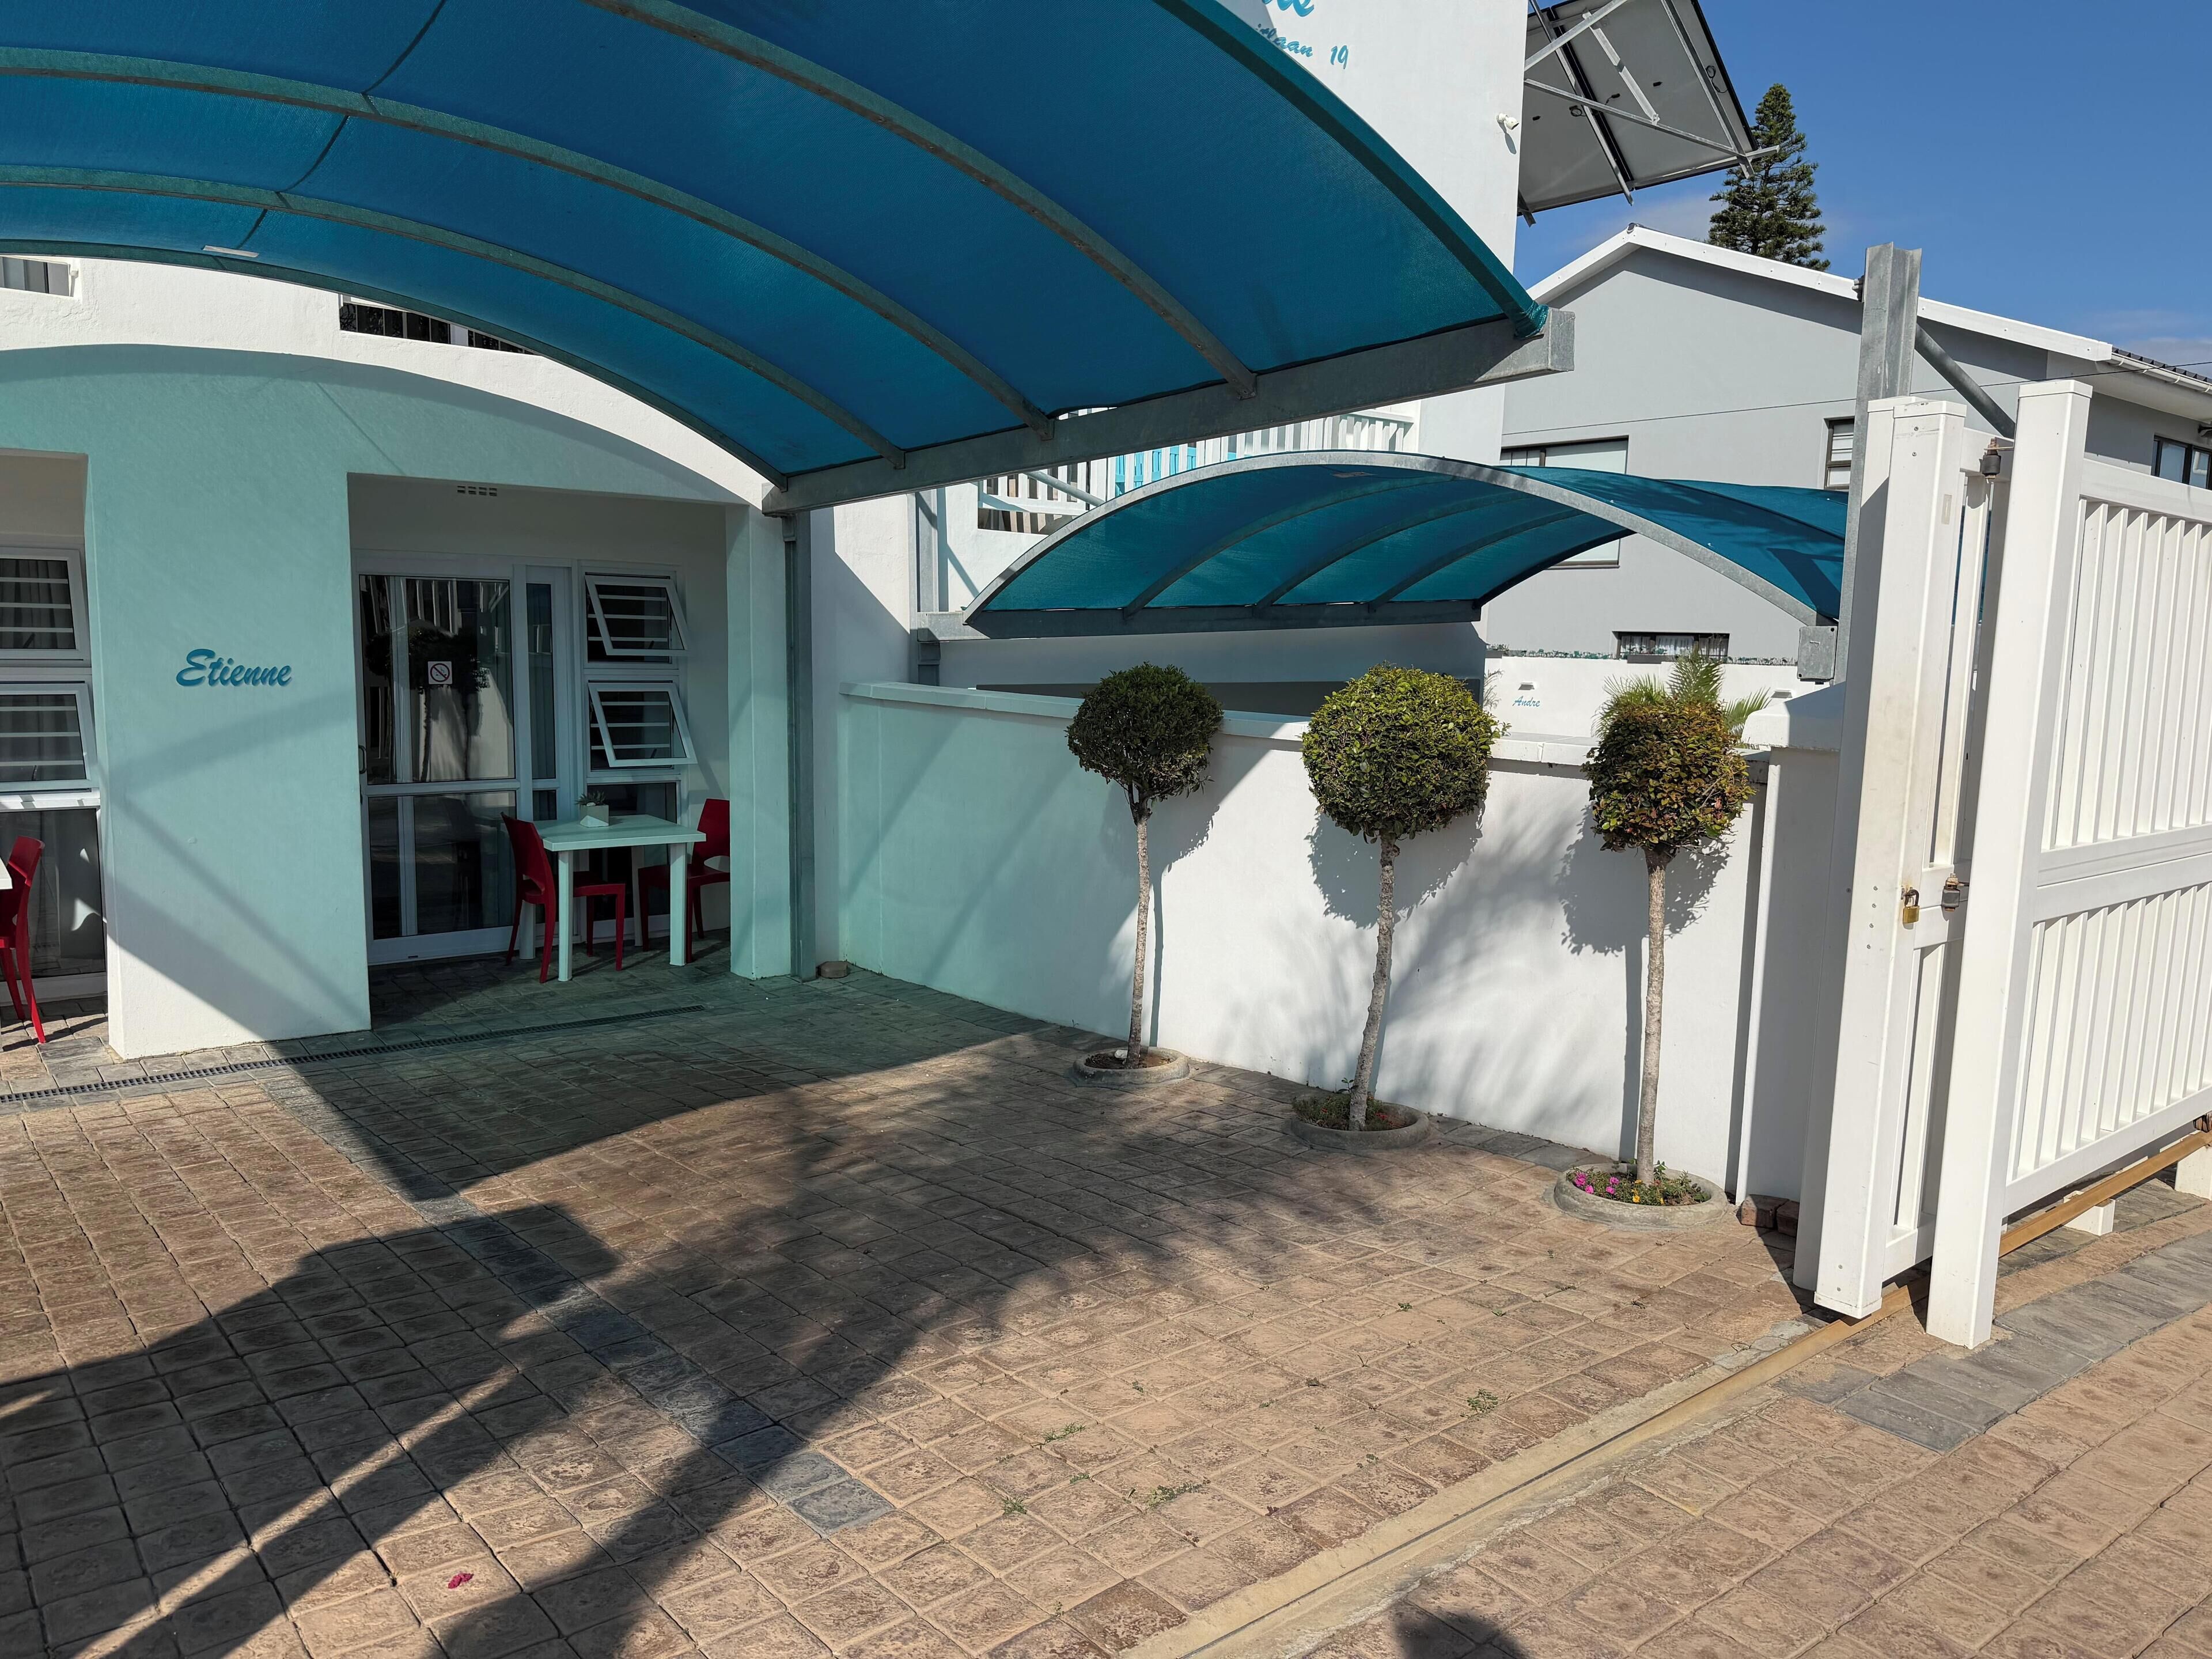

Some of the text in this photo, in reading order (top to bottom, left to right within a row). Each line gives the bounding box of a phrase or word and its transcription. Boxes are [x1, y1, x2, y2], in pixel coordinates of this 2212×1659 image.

[1330, 45, 1349, 69] 19
[176, 648, 292, 687] Etienne
[1512, 695, 1540, 707] Andre
